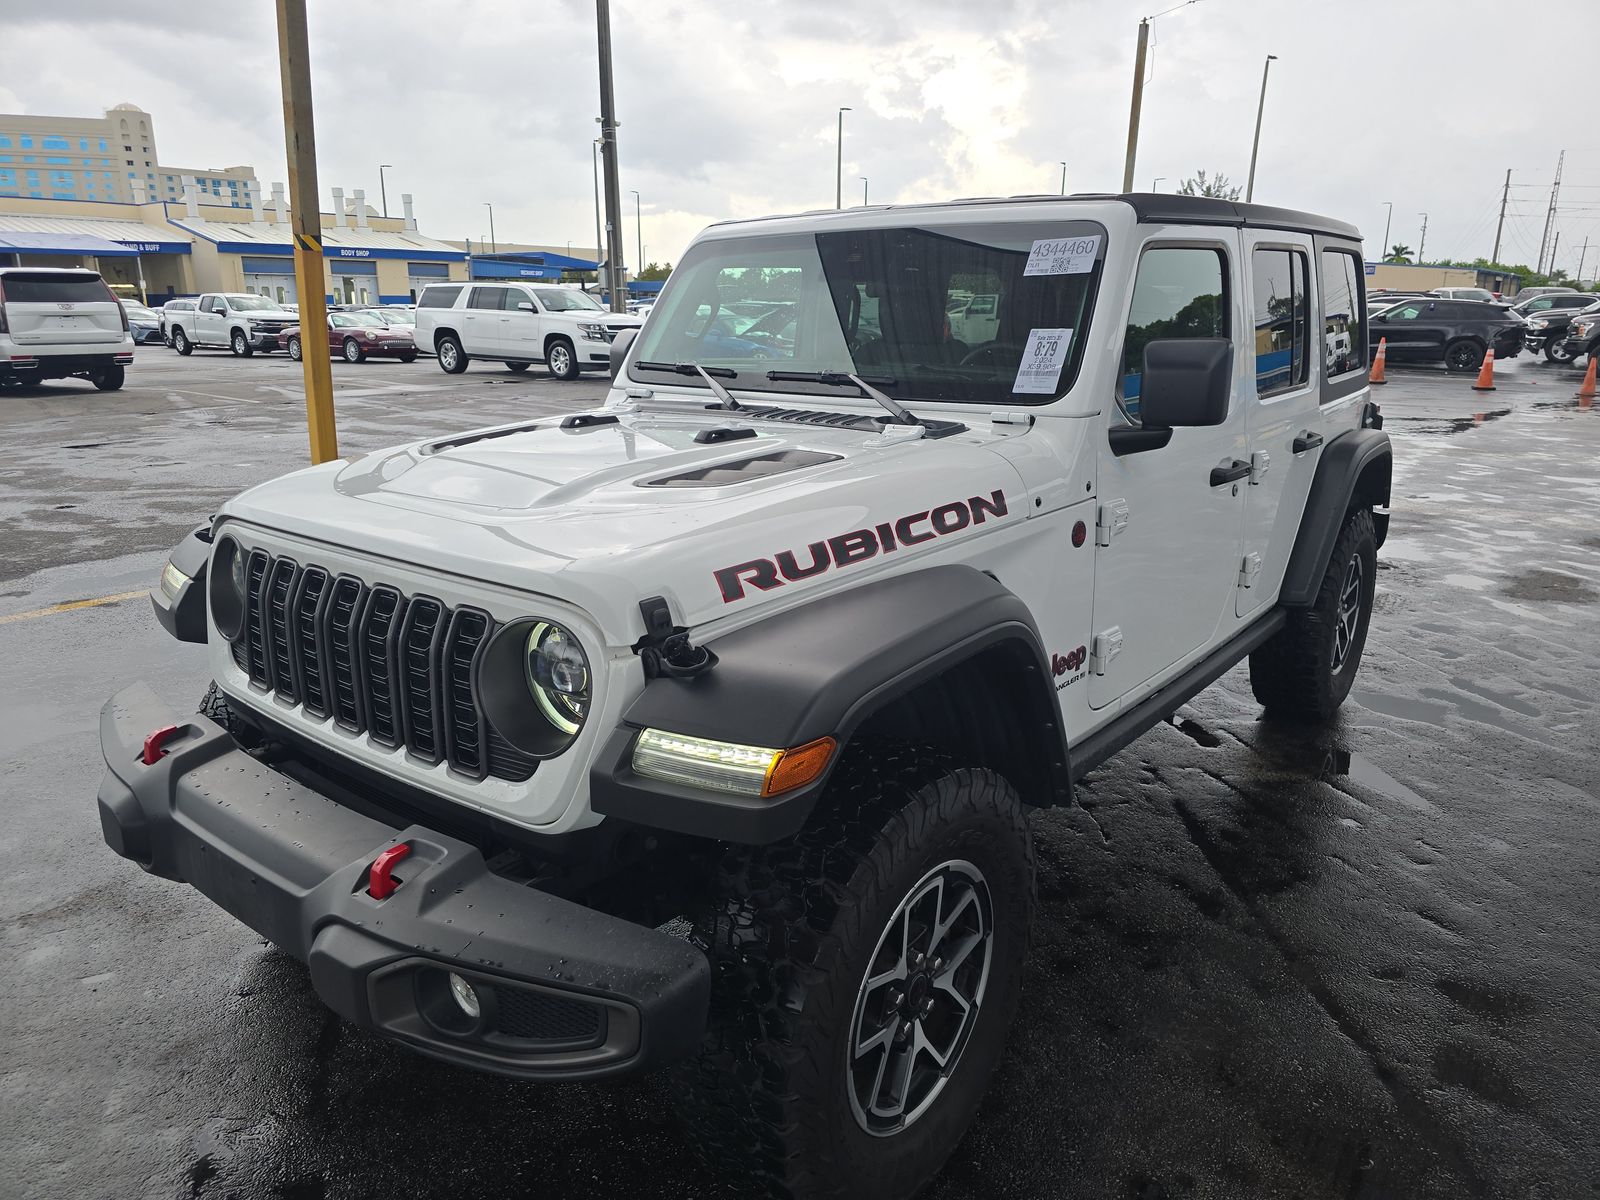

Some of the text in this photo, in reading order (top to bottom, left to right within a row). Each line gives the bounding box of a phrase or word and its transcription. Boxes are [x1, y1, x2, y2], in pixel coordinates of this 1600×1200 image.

[1033, 239, 1095, 258] 4344460
[1034, 341, 1058, 357] 8:79
[1034, 356, 1053, 364] 2024
[713, 488, 1009, 604] RUBICON
[1052, 644, 1087, 678] Jeep
